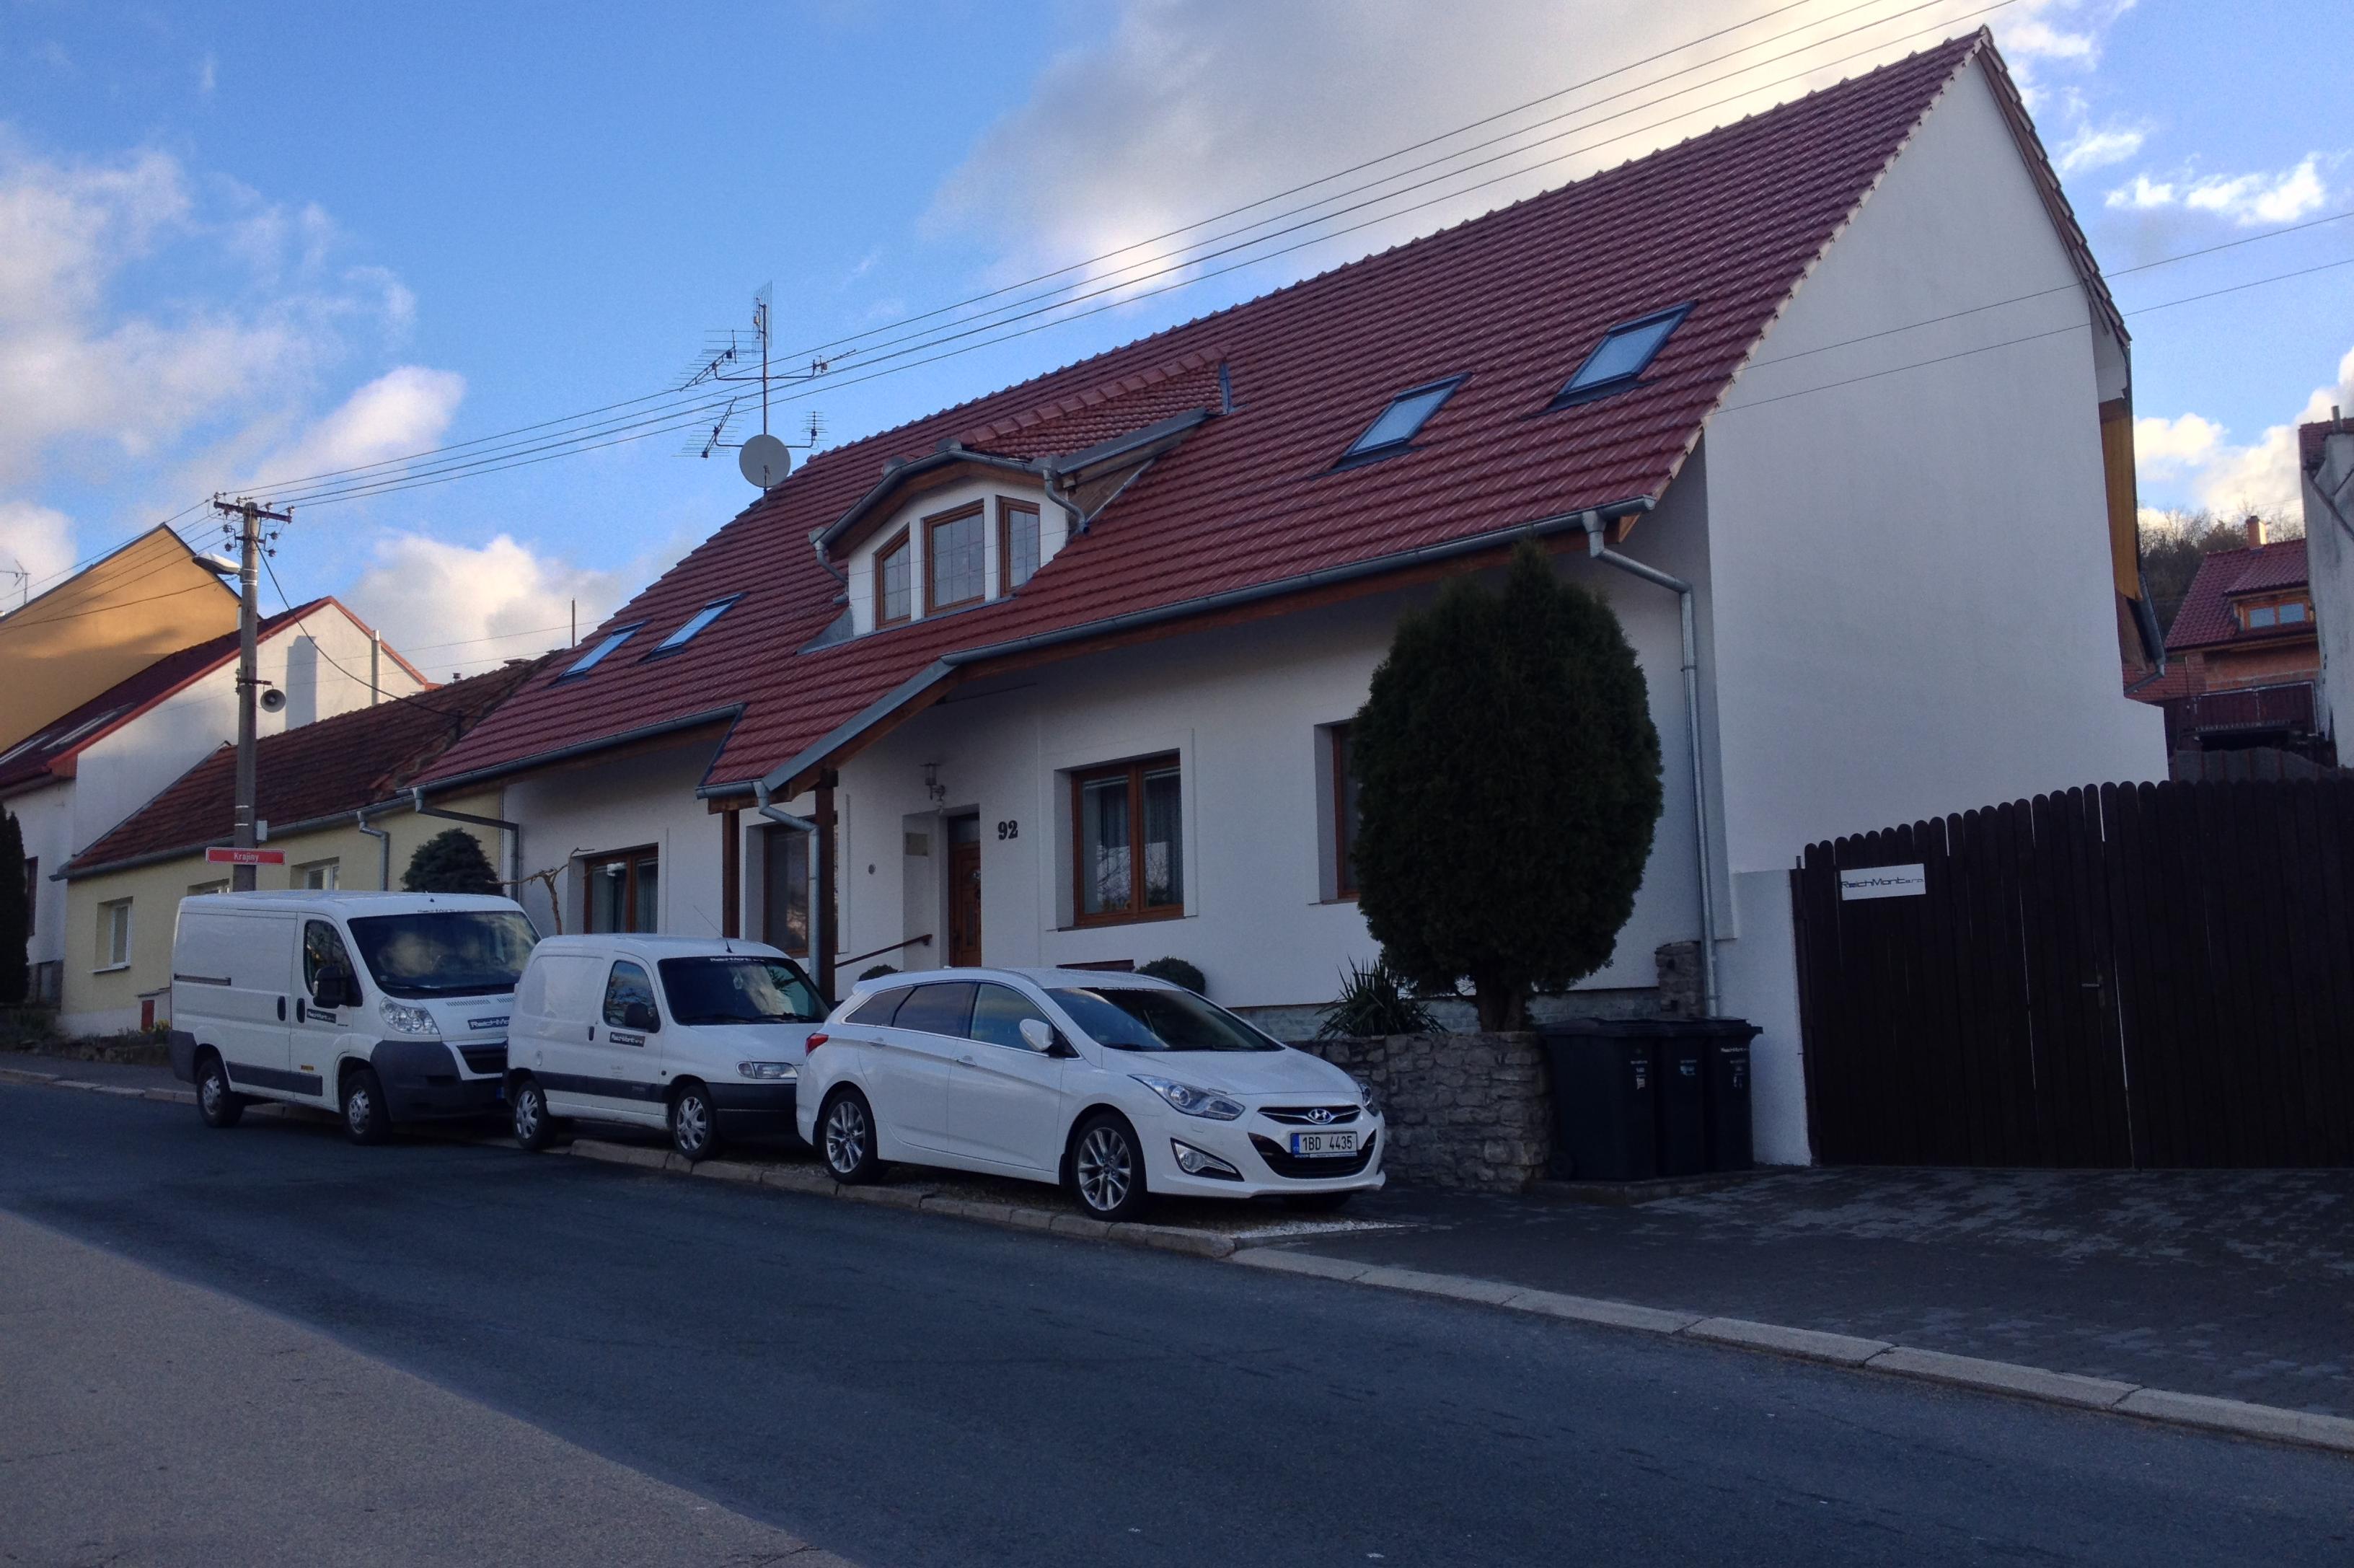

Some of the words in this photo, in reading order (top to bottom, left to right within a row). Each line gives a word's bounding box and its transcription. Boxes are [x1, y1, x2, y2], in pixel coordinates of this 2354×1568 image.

[997, 820, 1018, 840] 92
[234, 852, 259, 862] Krajiny
[1302, 1137, 1321, 1150] 1BD
[1329, 1135, 1352, 1150] 4435
